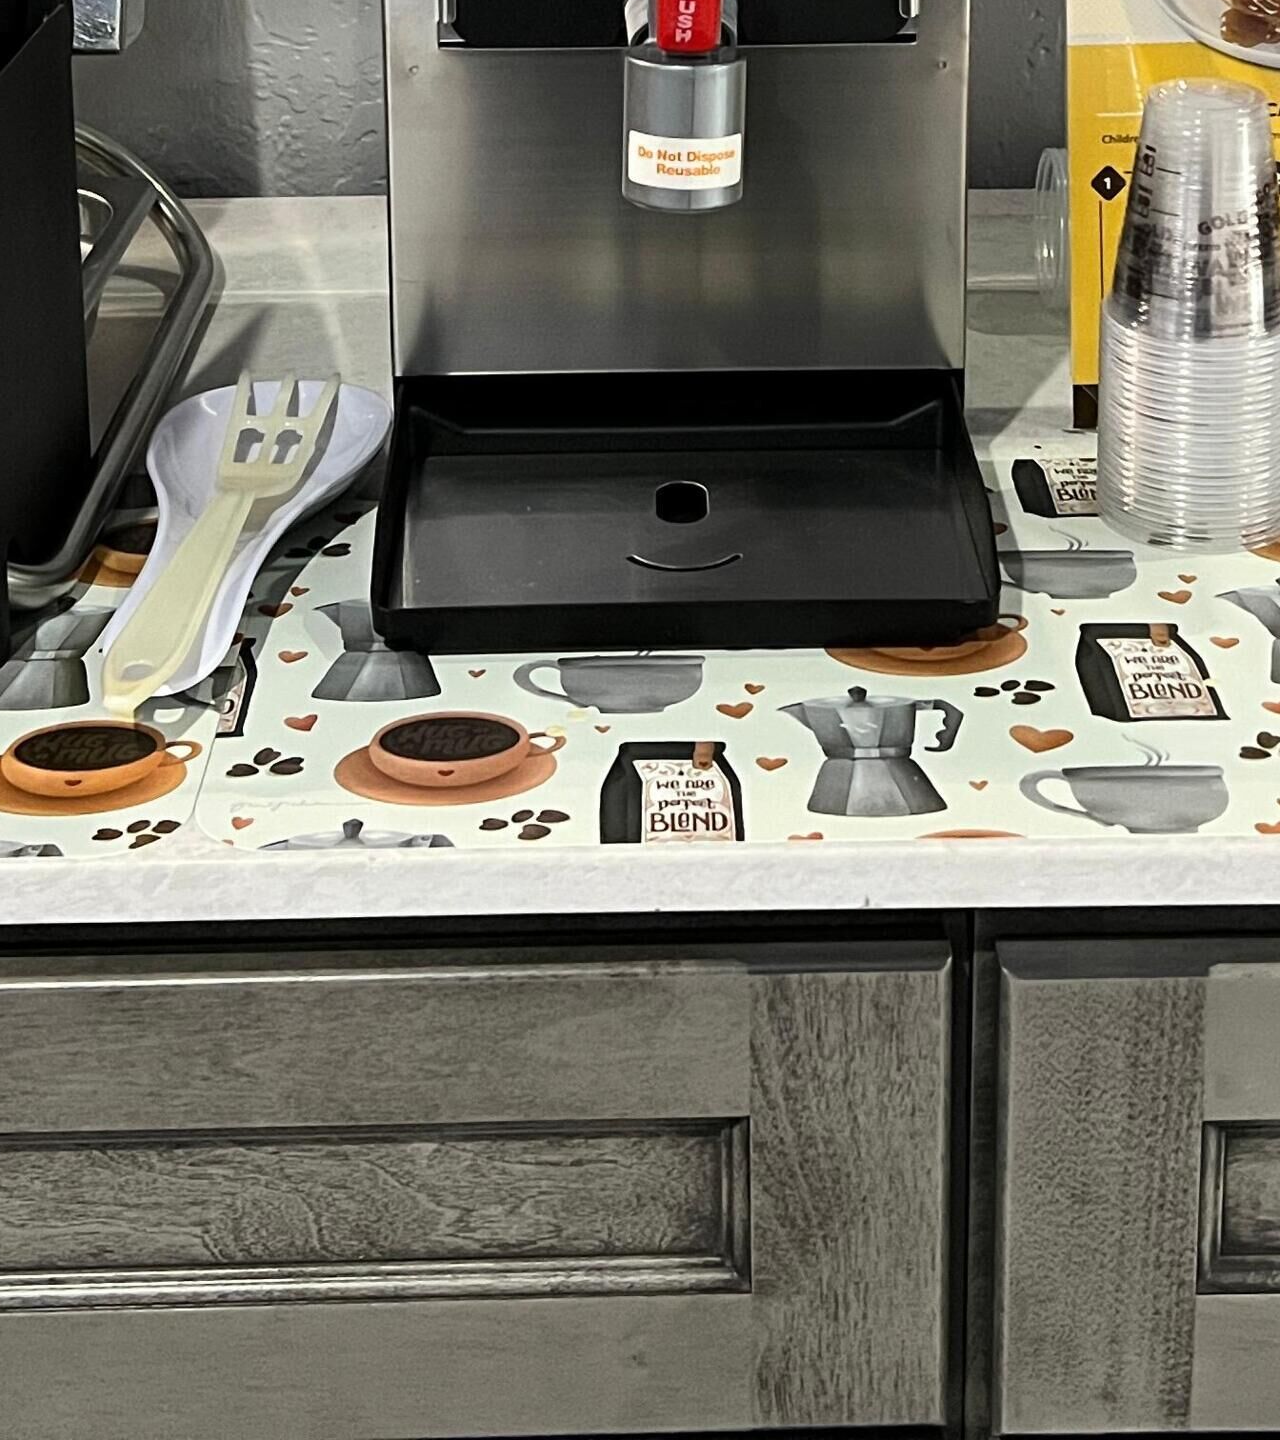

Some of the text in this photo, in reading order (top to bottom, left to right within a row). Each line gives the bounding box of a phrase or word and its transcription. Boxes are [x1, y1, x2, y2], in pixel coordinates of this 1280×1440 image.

[638, 145, 736, 165] Do Not Dispose
[656, 162, 721, 177] Reusable
[1103, 177, 1112, 190] 1
